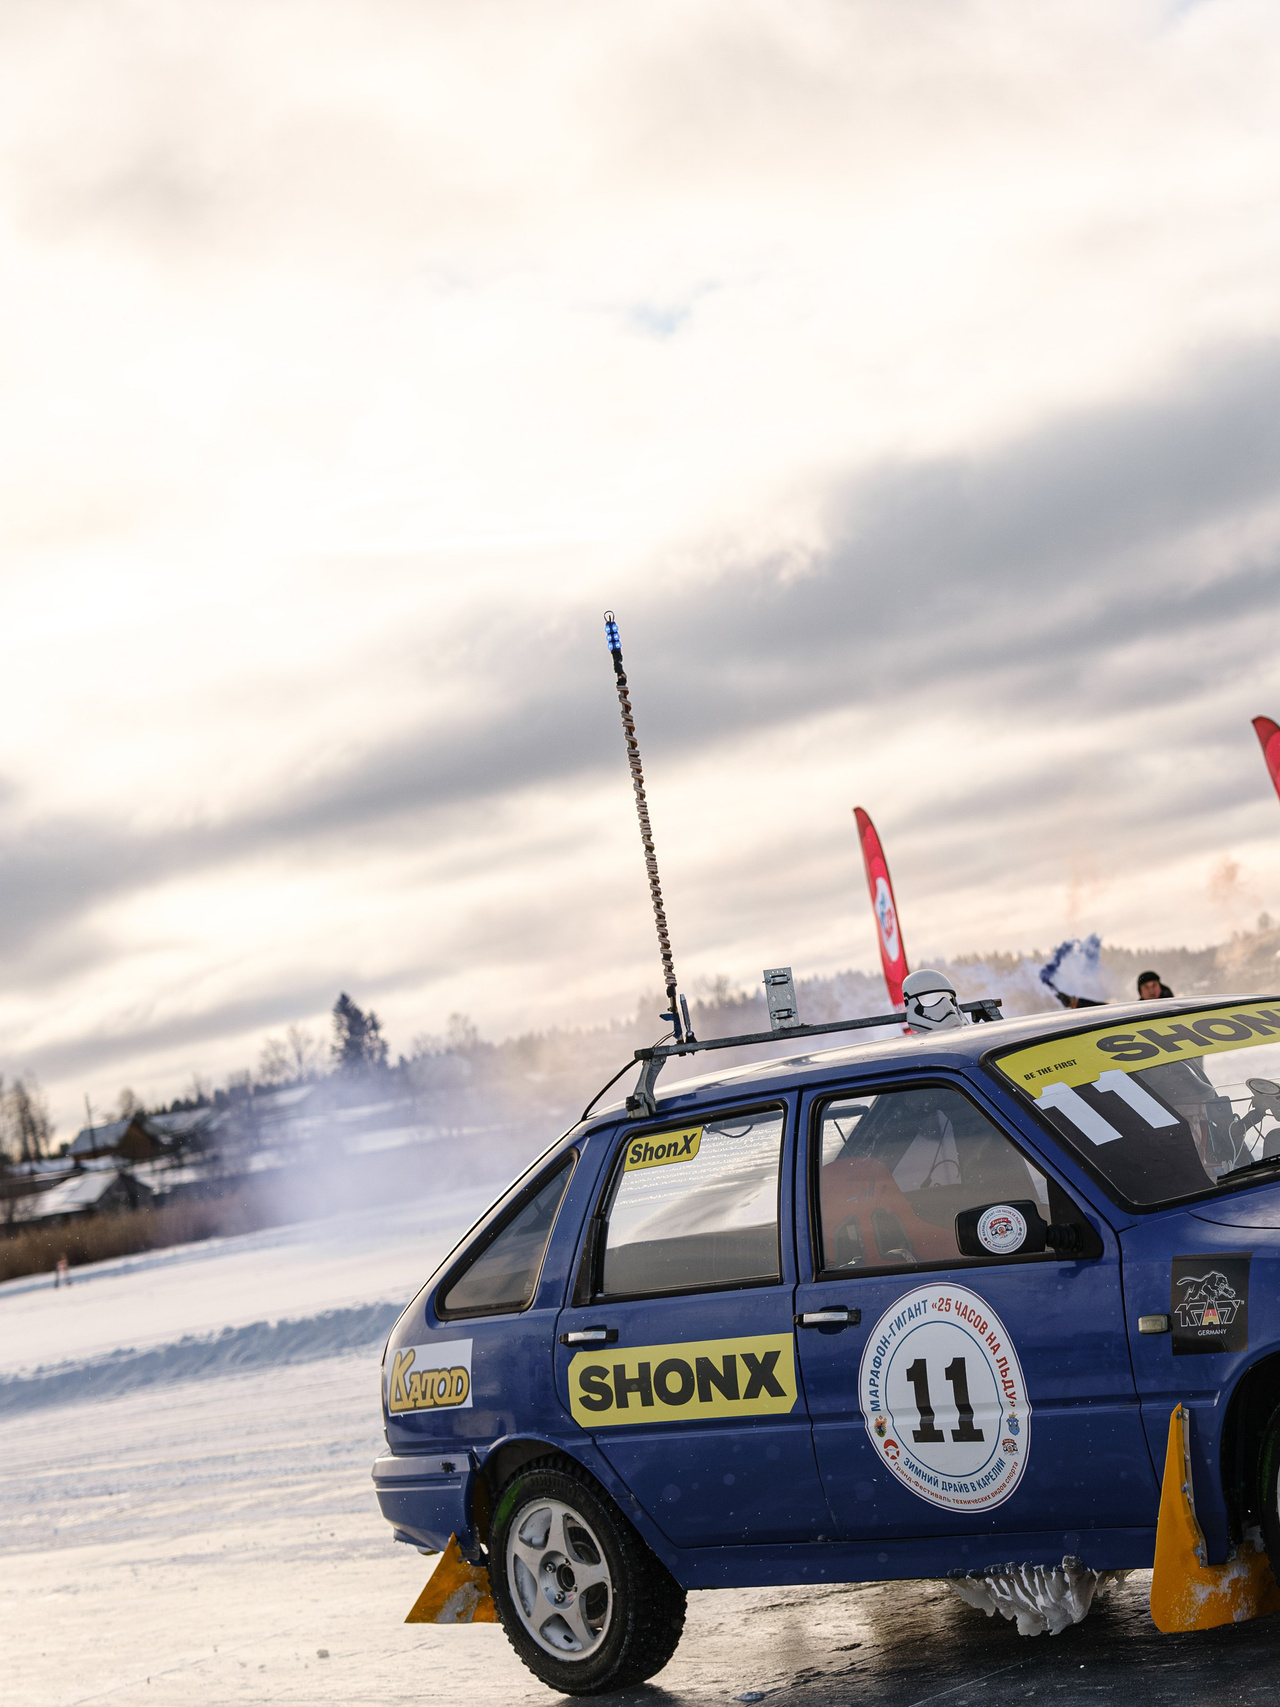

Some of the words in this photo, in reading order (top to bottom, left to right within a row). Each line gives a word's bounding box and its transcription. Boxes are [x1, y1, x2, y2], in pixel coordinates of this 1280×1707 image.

[1023, 1072, 1036, 1081] BE
[1036, 1066, 1054, 1076] THE
[1053, 1059, 1078, 1070] FIRST
[1033, 1069, 1180, 1146] 11
[629, 1133, 698, 1164] ShonX
[1197, 1328, 1227, 1337] GERMANY
[869, 1299, 928, 1412] МАРАФОН-ГИГАНТ
[931, 1297, 952, 1313] «25
[954, 1300, 989, 1336] ЧАСОВ
[985, 1331, 1001, 1356] НА
[578, 1350, 787, 1411] SHONX
[906, 1357, 985, 1442] 11
[903, 1457, 939, 1488] ЗИМНИЙ
[941, 1481, 970, 1493] ДРАЙВ
[971, 1482, 977, 1492] В
[977, 1457, 1007, 1490] КАРЕЛИИ
[1005, 1461, 1019, 1484] спорта
